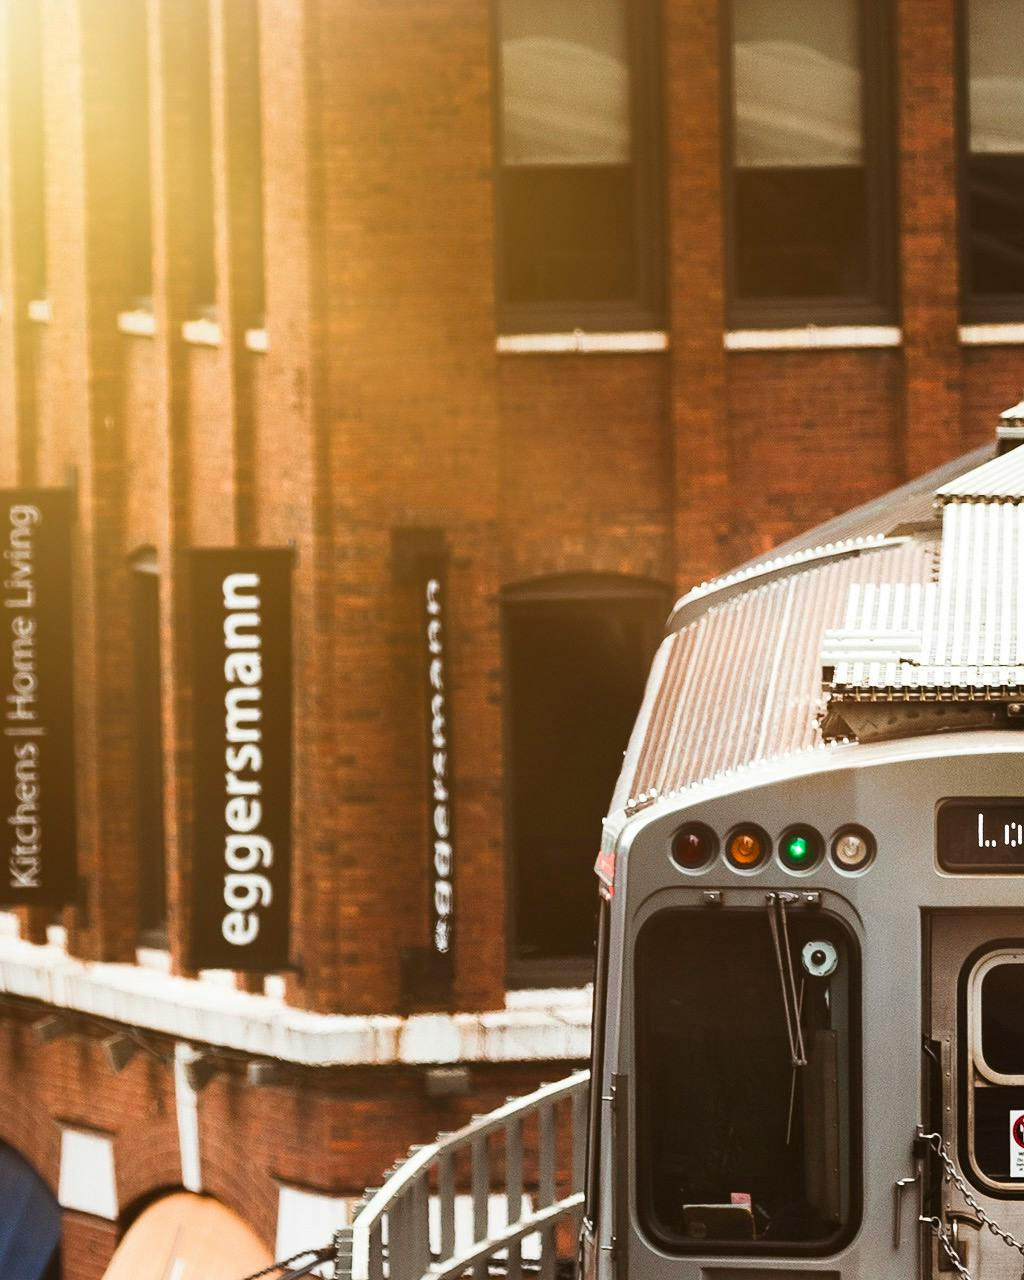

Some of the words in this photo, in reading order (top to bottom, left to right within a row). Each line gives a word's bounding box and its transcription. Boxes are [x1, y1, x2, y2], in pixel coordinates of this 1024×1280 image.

[4, 503, 42, 608] Living
[8, 615, 37, 721] Home
[8, 742, 40, 888] Kitchens
[220, 572, 274, 947] eggersmann
